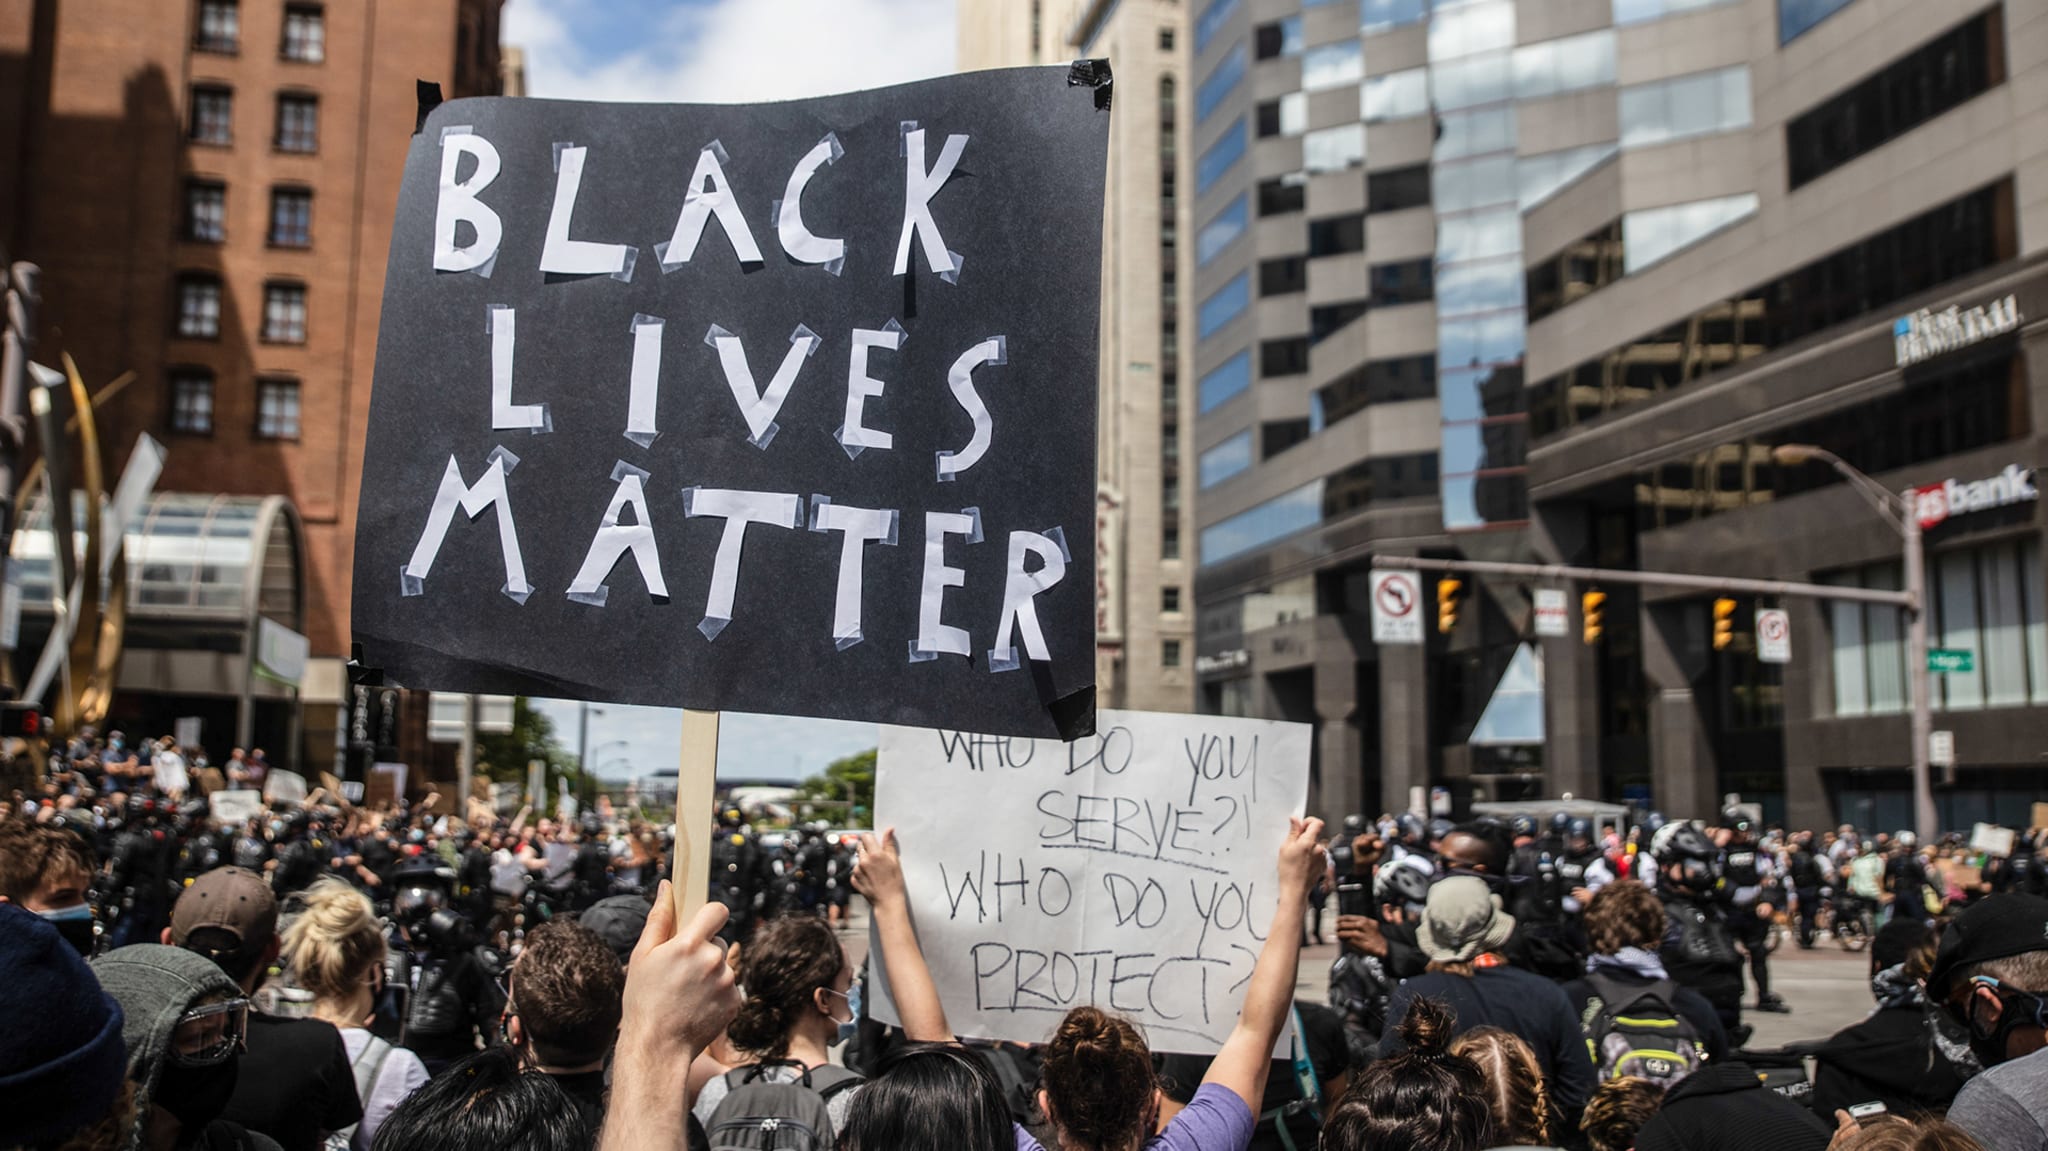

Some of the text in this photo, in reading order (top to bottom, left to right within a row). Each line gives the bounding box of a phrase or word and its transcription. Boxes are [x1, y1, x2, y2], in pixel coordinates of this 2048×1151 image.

[432, 129, 969, 276] BLACK
[491, 308, 1000, 474] LIVES
[406, 452, 1067, 661] MATTER
[938, 727, 1258, 807] WHO DO YOU
[939, 849, 1072, 923] WHO
[1102, 872, 1167, 929] DO
[970, 942, 1258, 1024] PROTECT?
